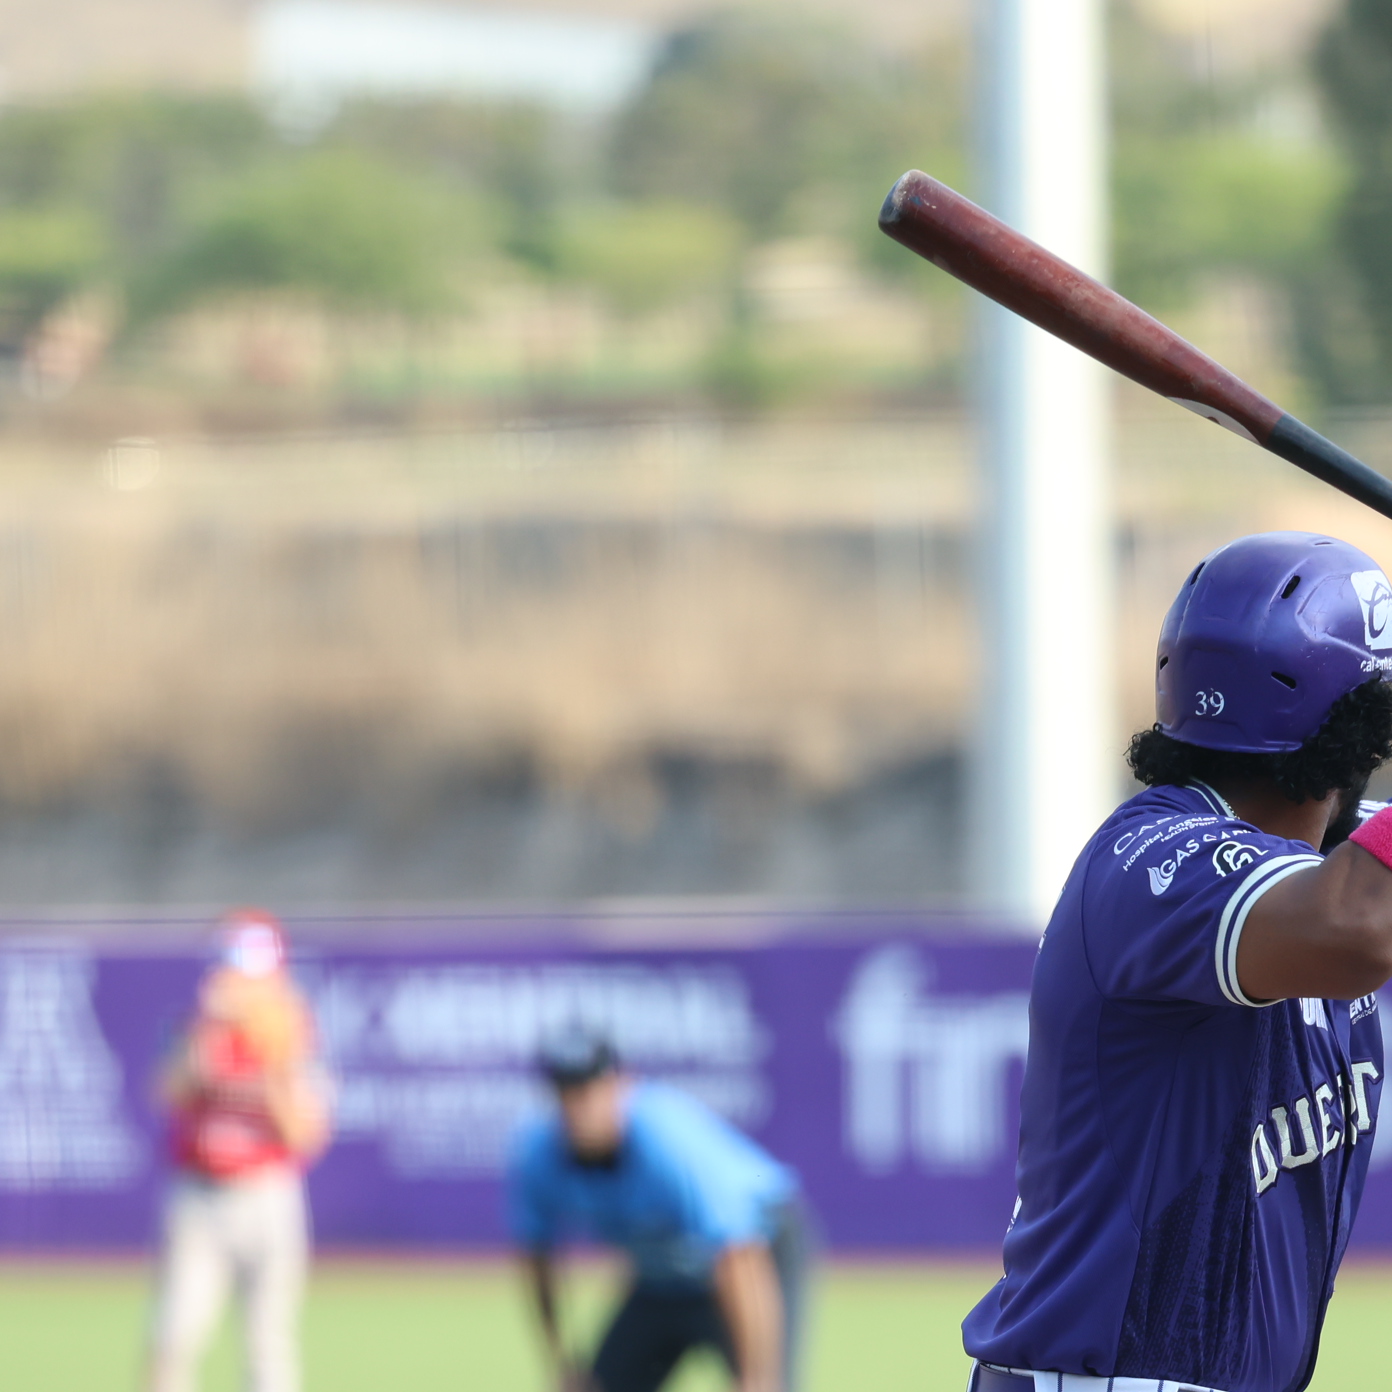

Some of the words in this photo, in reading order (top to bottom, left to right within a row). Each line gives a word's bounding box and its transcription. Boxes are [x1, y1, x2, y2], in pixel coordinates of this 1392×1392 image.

[1195, 691, 1225, 717] 39
[1122, 831, 1164, 872] Hospital
[1159, 838, 1200, 878] GAS
